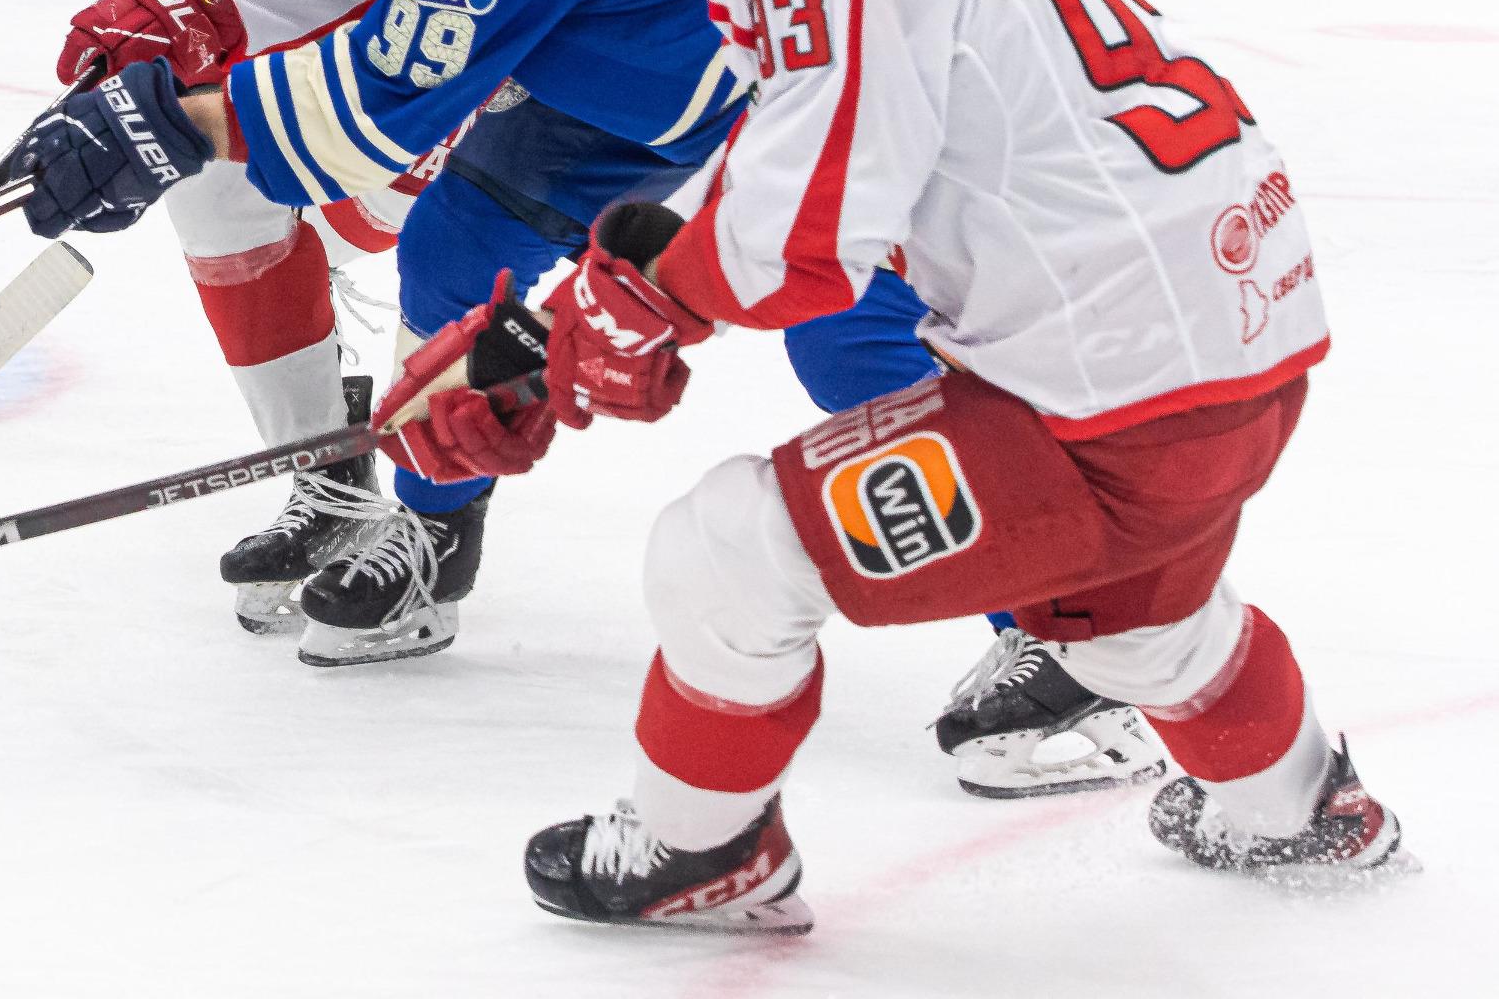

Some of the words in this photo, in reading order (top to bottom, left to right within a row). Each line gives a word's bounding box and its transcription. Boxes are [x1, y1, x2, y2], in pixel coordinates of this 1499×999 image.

[100, 74, 181, 186] BAUER
[147, 450, 316, 510] JETSPEED
[873, 468, 931, 562] Win
